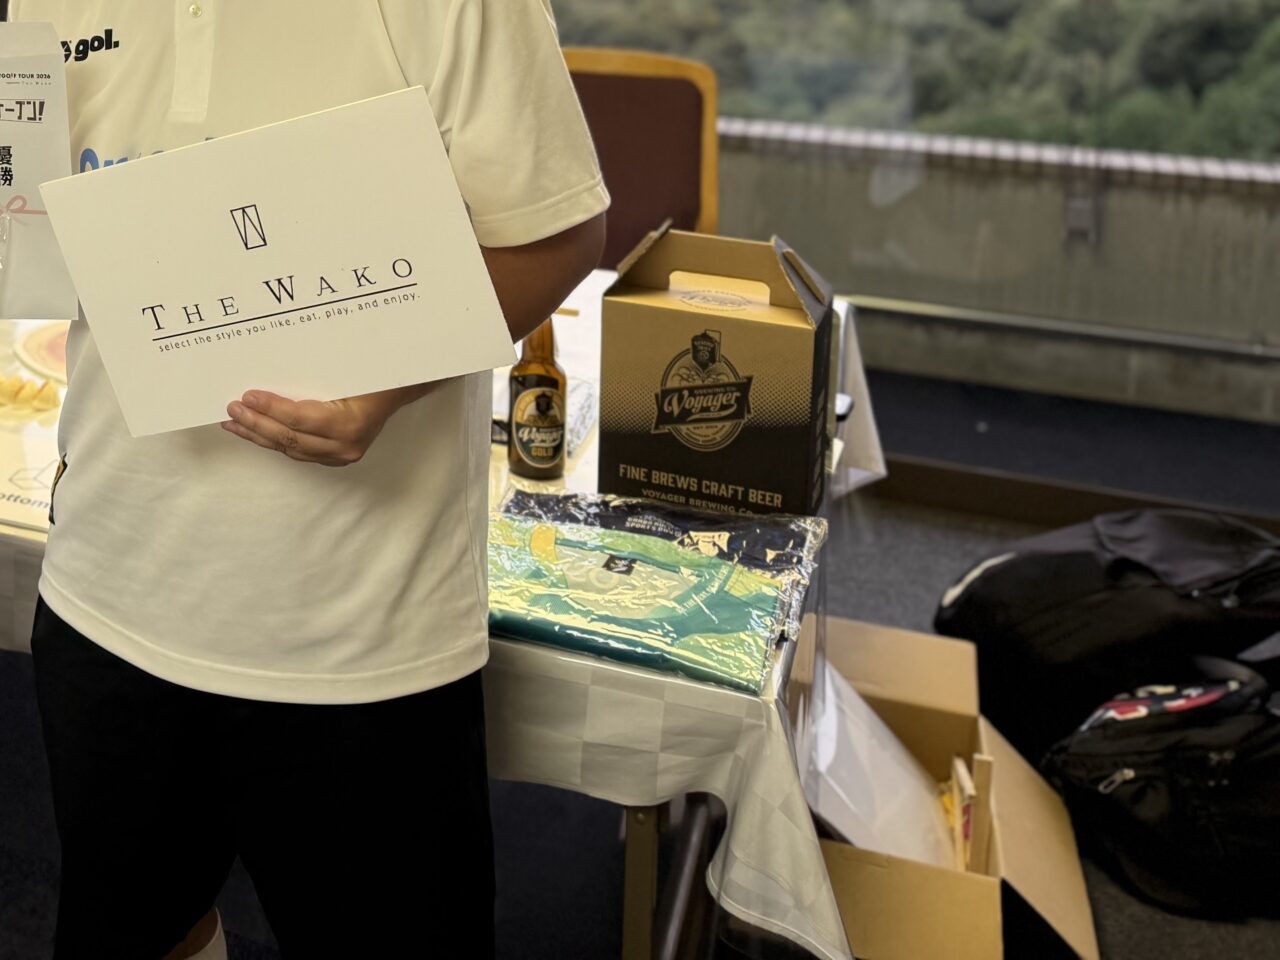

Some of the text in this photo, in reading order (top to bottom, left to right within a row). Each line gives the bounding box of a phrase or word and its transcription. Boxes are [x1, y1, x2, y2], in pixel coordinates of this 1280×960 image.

[158, 292, 421, 353] select the style you like, eat, play, and enjoy.
[663, 389, 741, 418] Voyager
[619, 464, 783, 508] FINE BREWS CRAFT BEER
[641, 489, 686, 504] VOYAGER
[689, 497, 736, 514] BREWING
